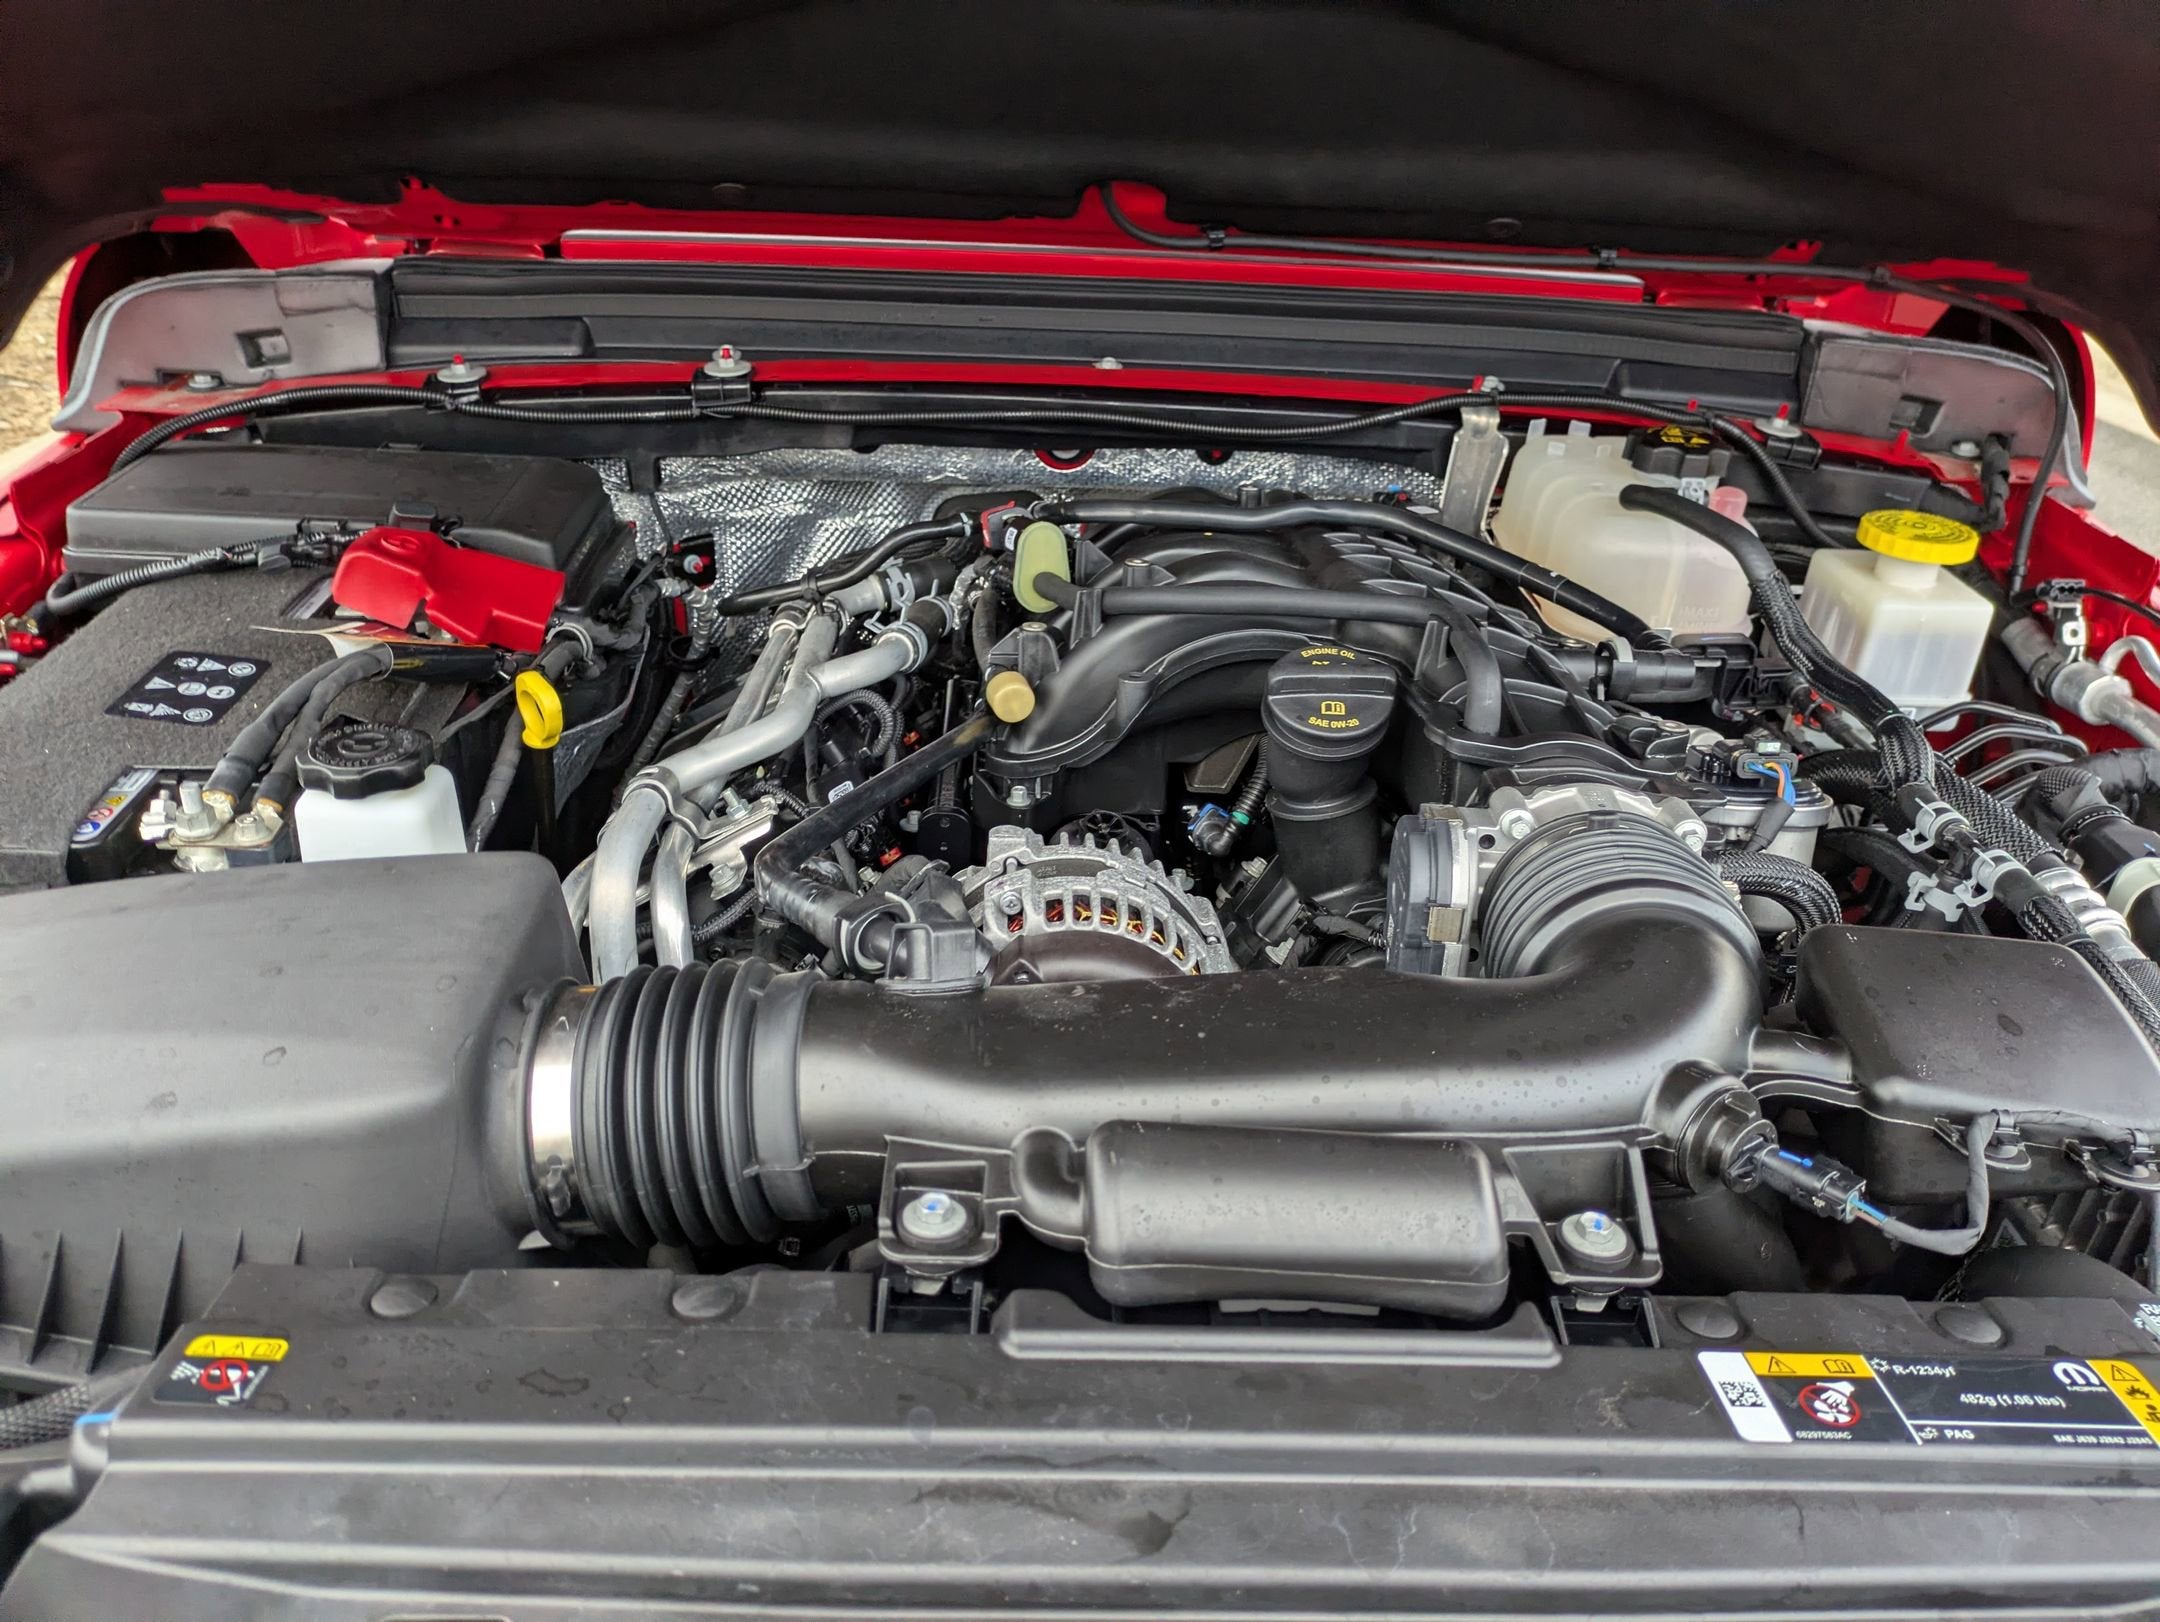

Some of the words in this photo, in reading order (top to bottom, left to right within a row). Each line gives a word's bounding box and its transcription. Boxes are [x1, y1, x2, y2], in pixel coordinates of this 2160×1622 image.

[1301, 648, 1338, 658] ENGINE
[1340, 650, 1356, 660] OIL
[1308, 716, 1329, 728] SAE
[1330, 718, 1360, 729] 0W-20
[1892, 1364, 1956, 1378] R-1234yf
[1960, 1393, 1997, 1407] 482g
[2033, 1395, 2066, 1408] lbs)
[1944, 1429, 1975, 1440] PAG
